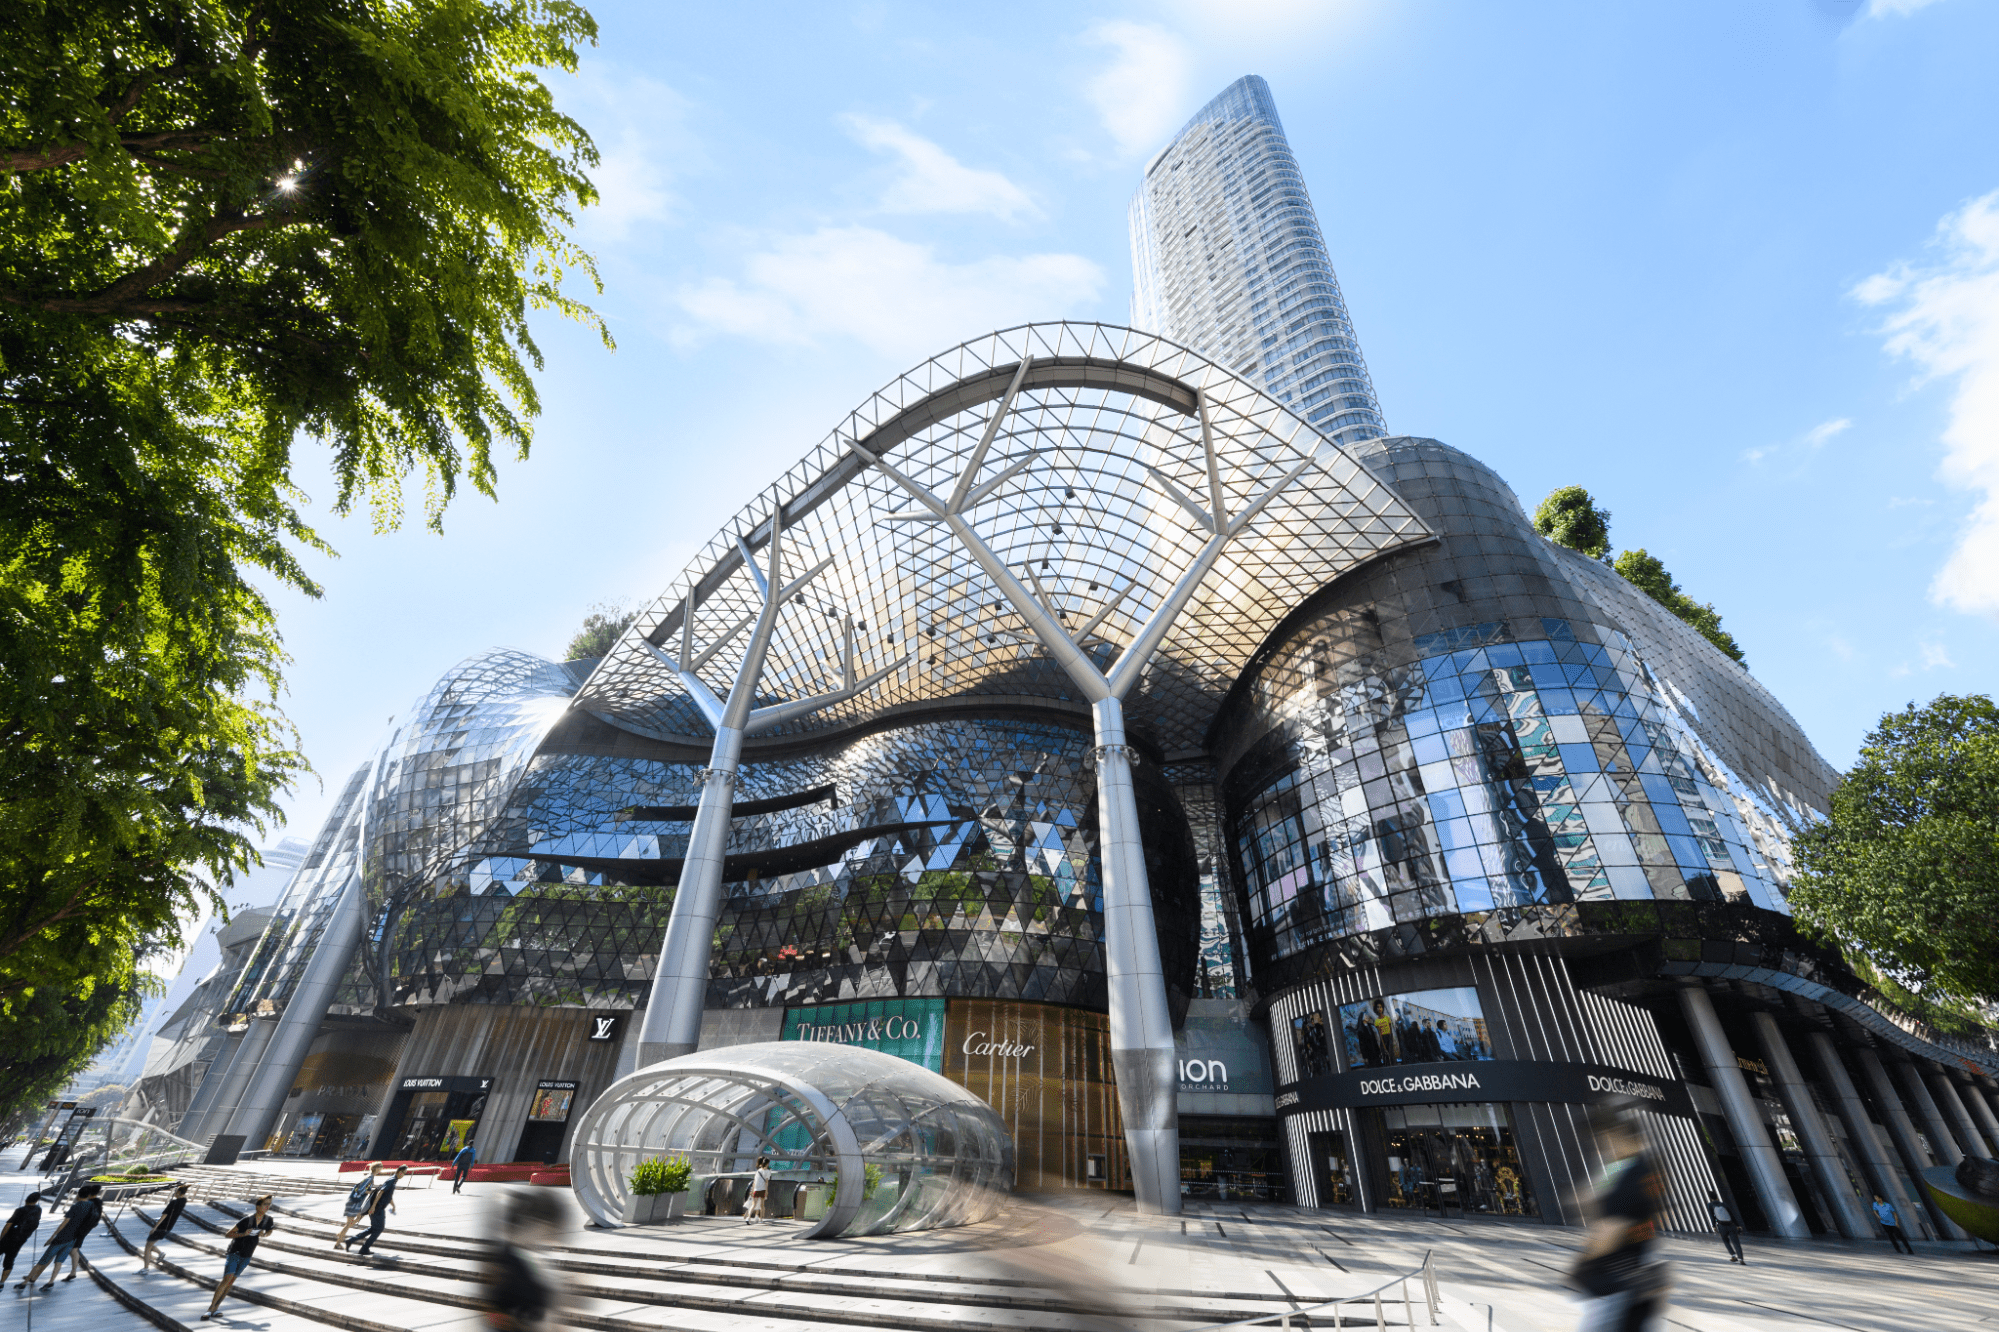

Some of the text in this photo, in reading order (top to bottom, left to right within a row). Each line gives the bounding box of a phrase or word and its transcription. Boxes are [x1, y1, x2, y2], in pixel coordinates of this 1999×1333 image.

[962, 1031, 1035, 1058] Cartier
[403, 1079, 442, 1087] LOUIS VUITTON
[1181, 1083, 1229, 1091] ORCHARD
